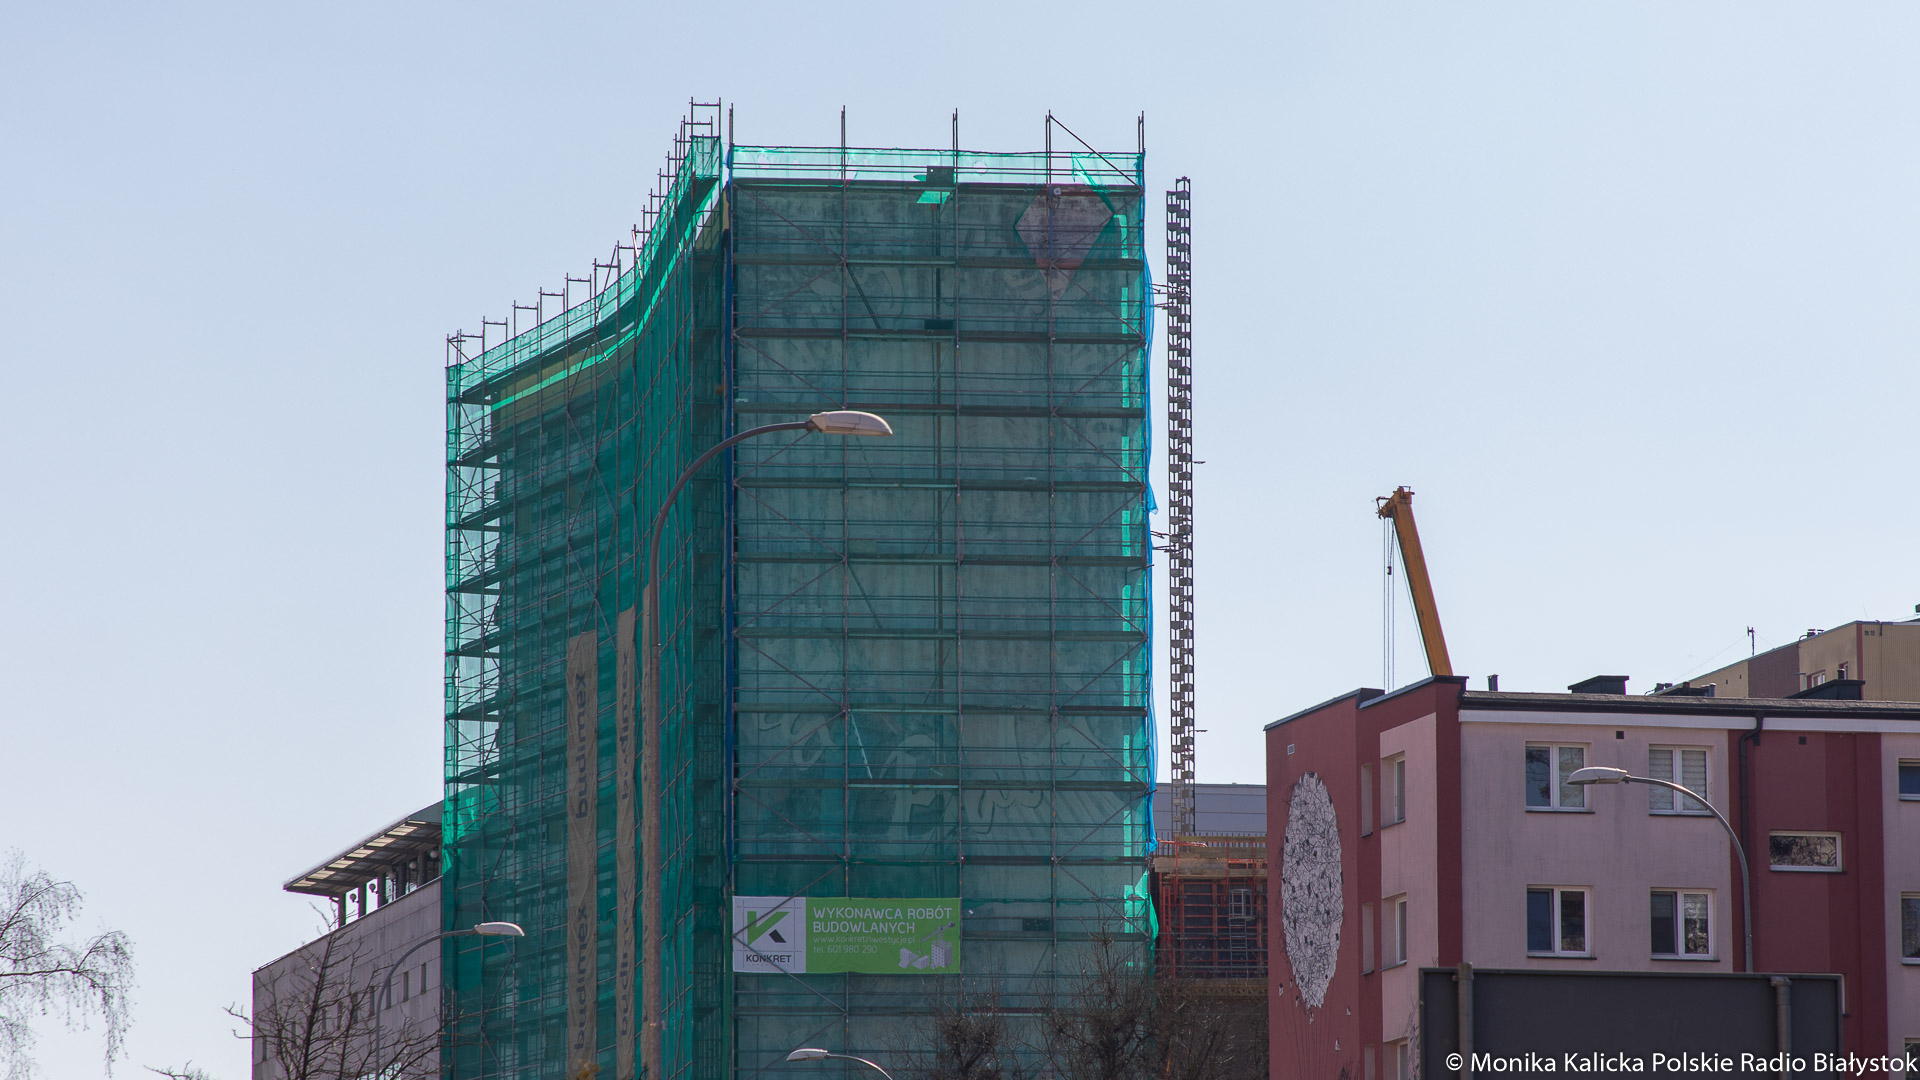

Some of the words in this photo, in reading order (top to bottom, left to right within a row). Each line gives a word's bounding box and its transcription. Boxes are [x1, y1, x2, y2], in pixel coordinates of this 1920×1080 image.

[575, 671, 588, 818] budimex
[813, 907, 903, 920] WYKONAWCA
[907, 905, 953, 920] ROBÓT
[813, 921, 915, 934] BUDOWLANYCH
[813, 935, 916, 946] www.konkretinwestycje.pl
[827, 945, 842, 954] 601
[843, 945, 860, 954] 980
[861, 945, 878, 954] 290
[746, 954, 792, 963] KONKRET
[574, 903, 588, 1050] budimex
